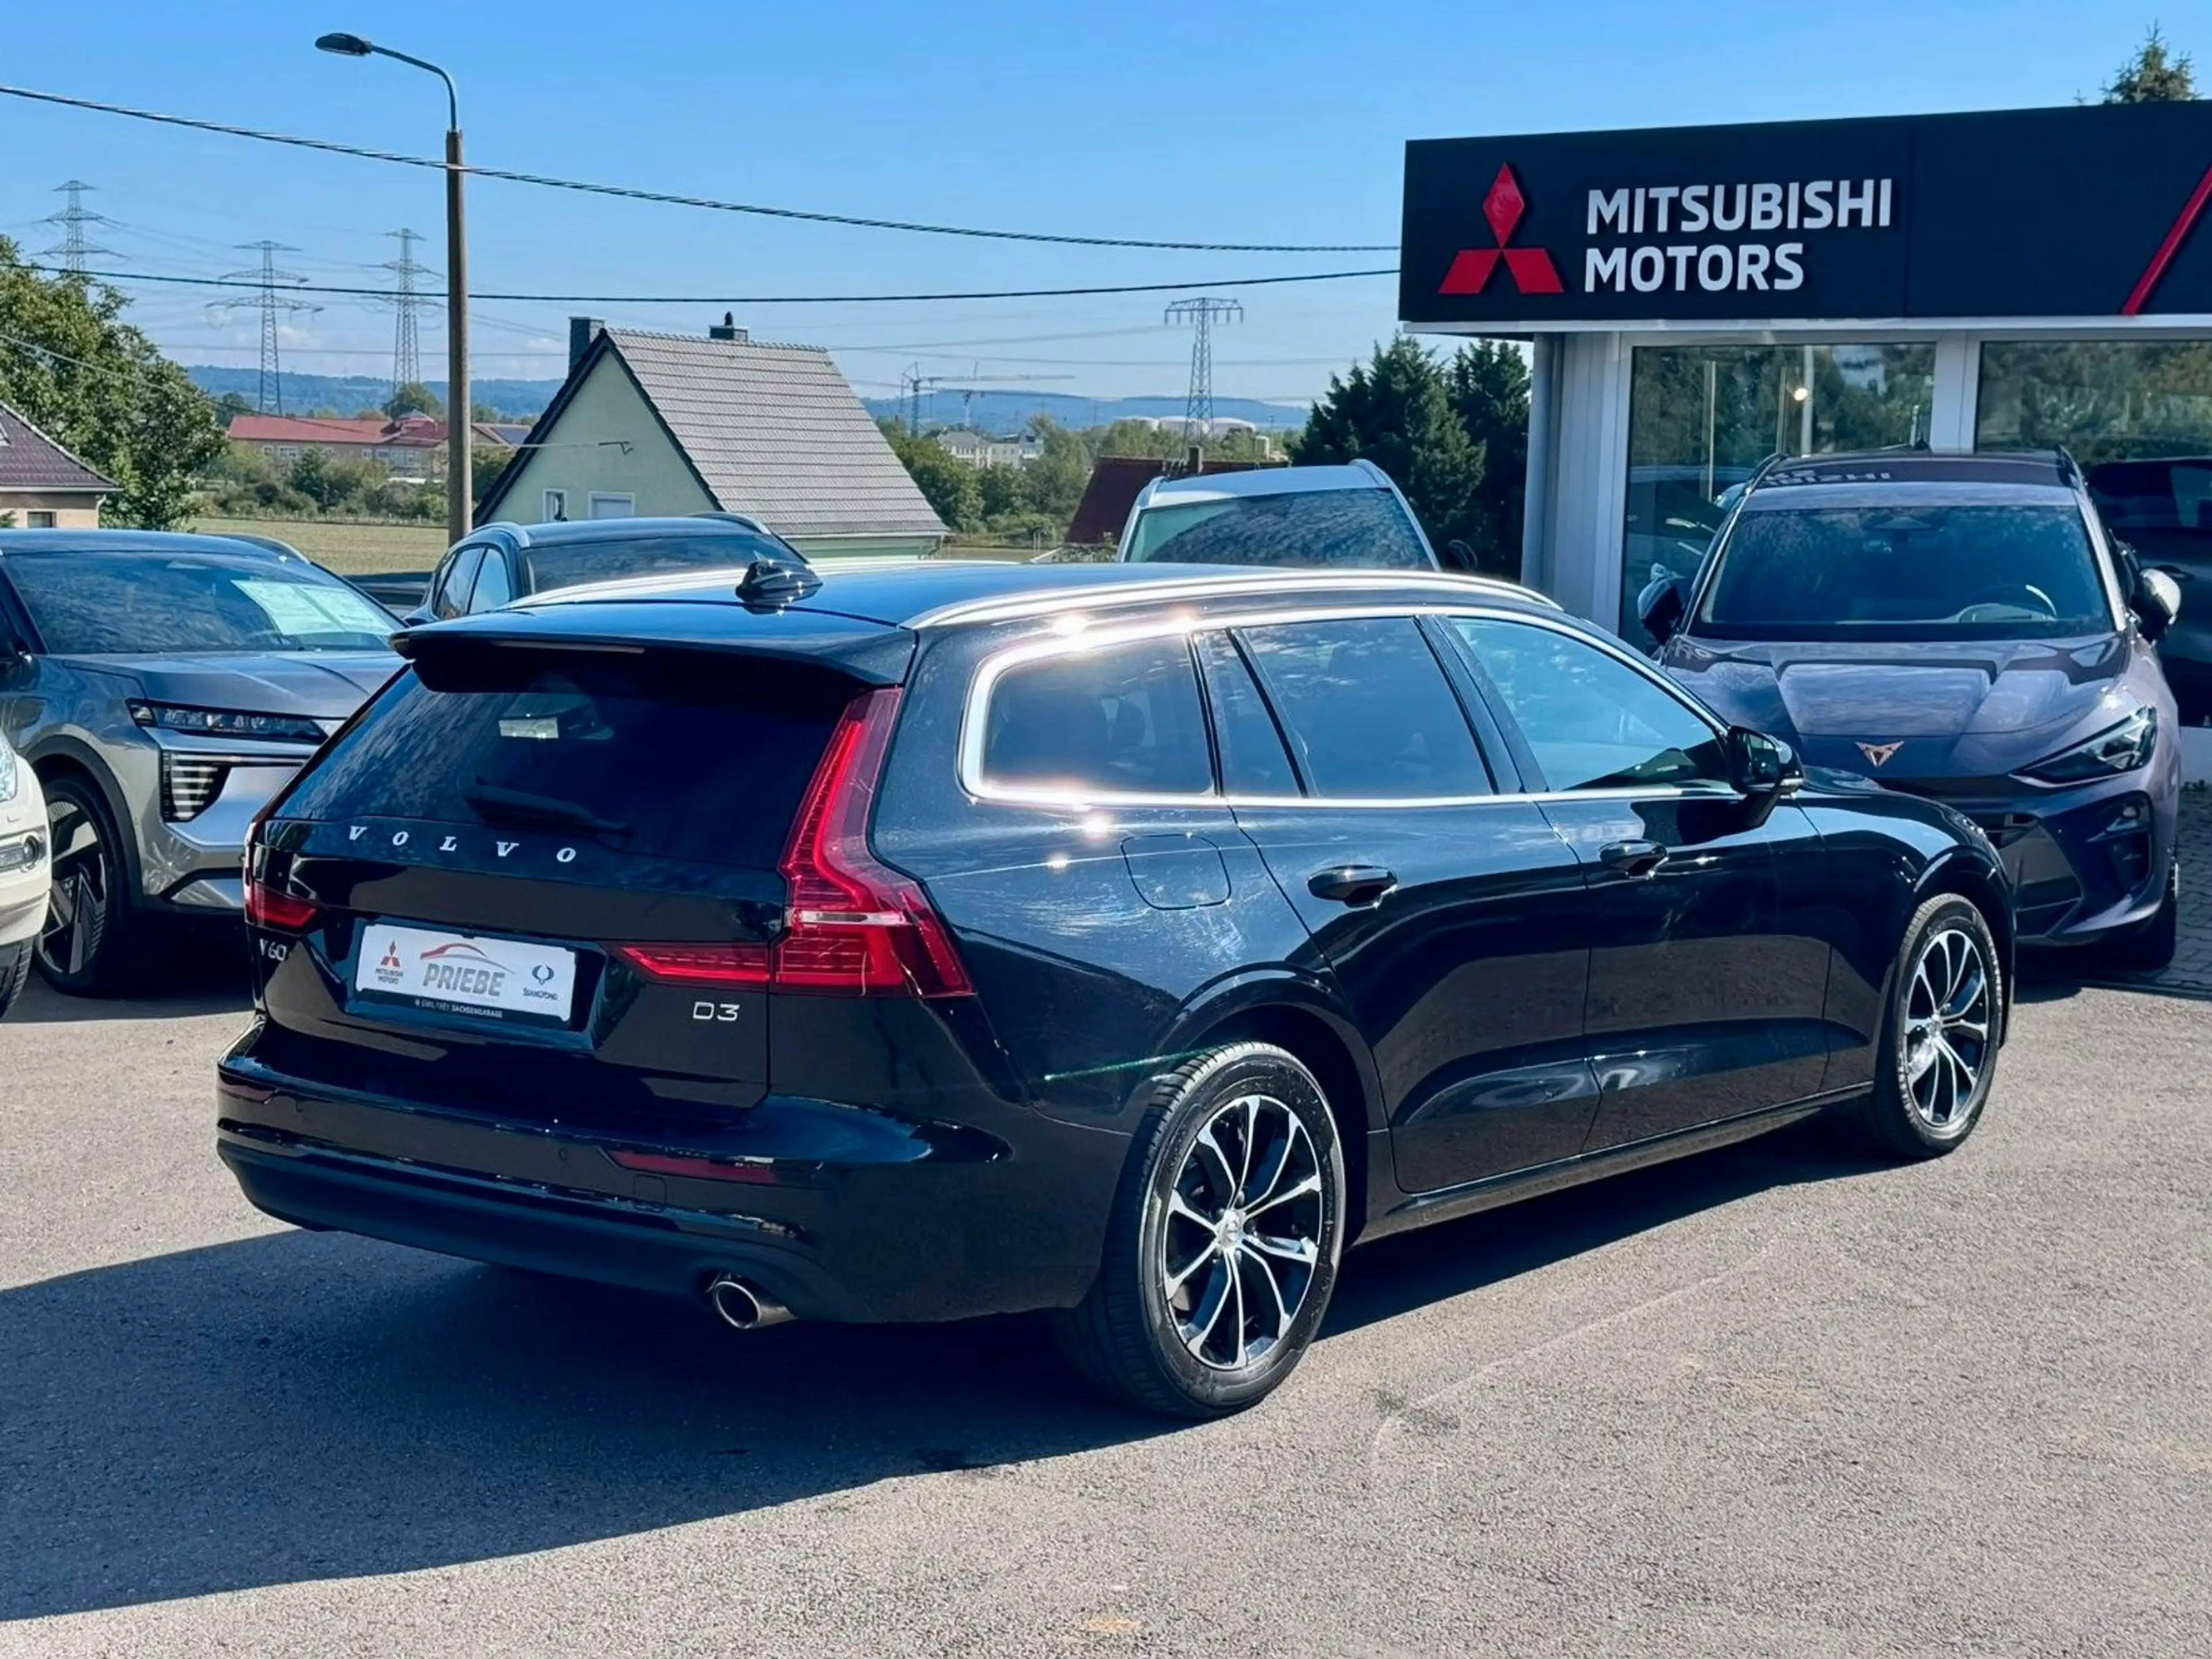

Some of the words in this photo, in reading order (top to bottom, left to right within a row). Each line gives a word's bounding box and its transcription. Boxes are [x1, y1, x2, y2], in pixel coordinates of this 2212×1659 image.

[1586, 179, 1892, 234] MITSUBISHI
[1584, 243, 1804, 292] MOTORS
[349, 825, 577, 862] VOLVO
[259, 938, 287, 961] V60
[423, 963, 505, 997] PRIEBE
[693, 1001, 740, 1021] D3
